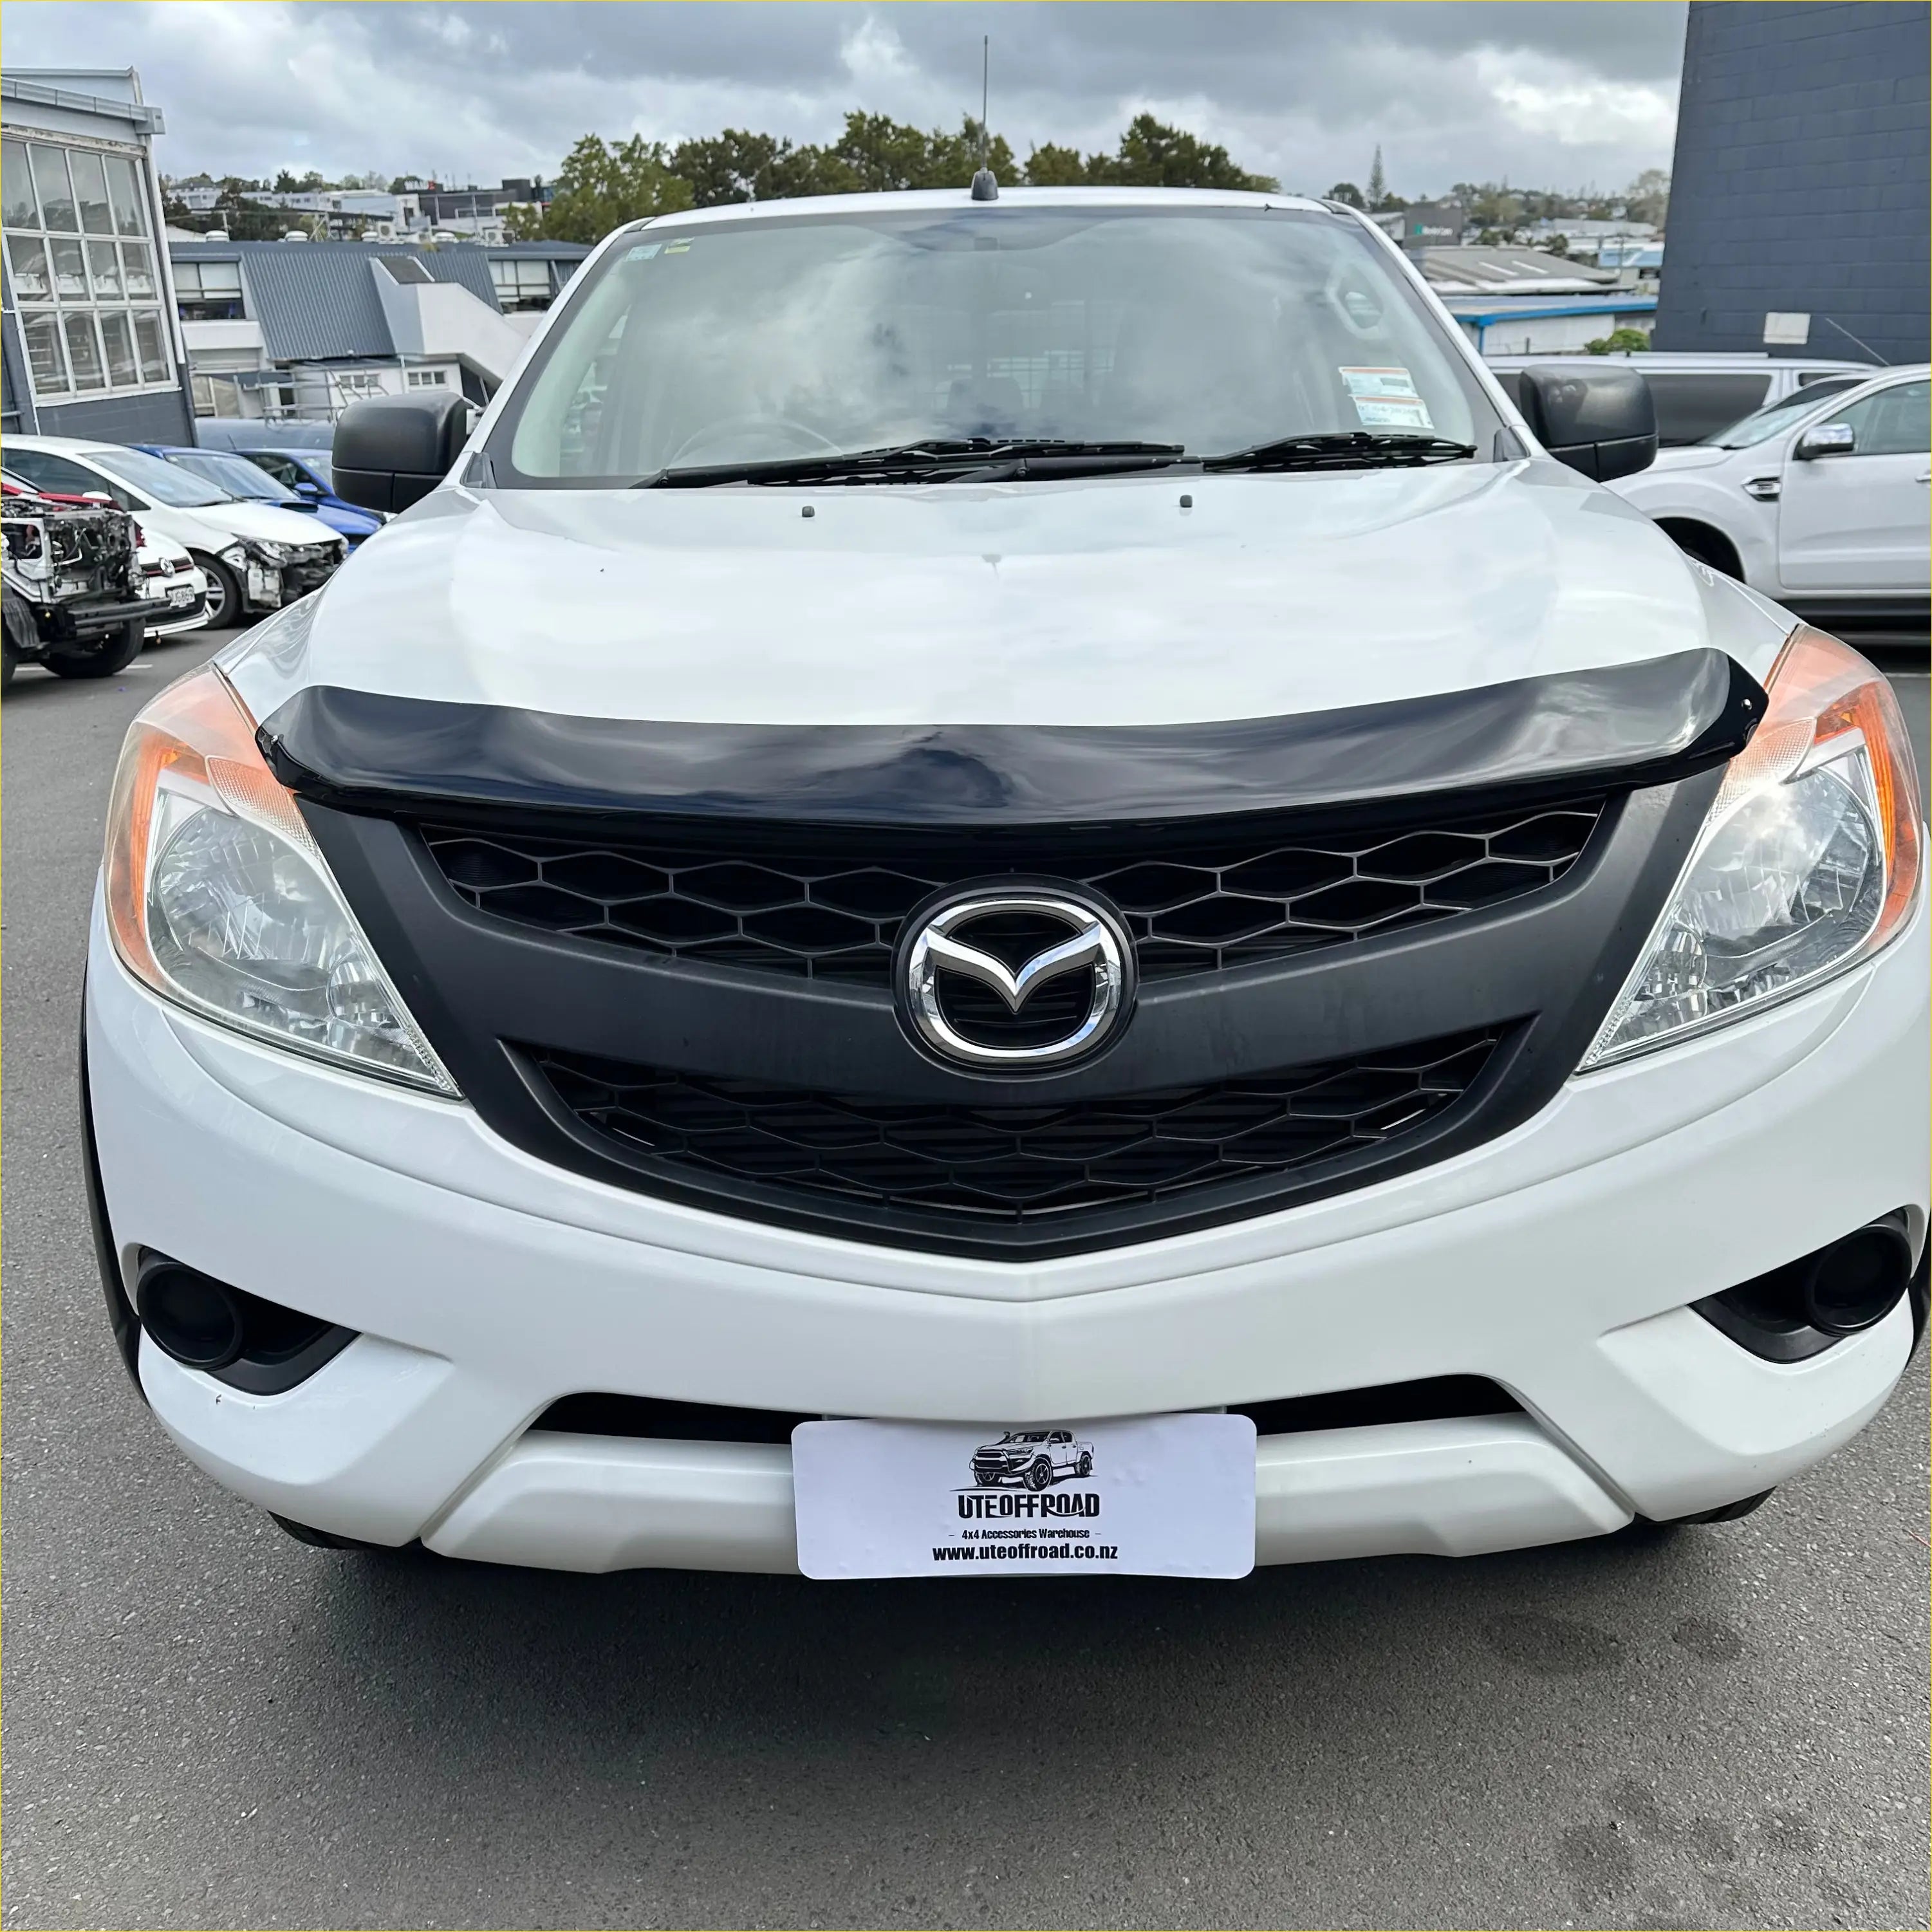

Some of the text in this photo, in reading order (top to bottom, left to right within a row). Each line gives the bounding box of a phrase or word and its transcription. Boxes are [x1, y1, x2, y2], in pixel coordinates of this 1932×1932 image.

[958, 1493, 1100, 1519] UTEOFFROAD
[961, 1528, 1090, 1540] 4x4 Accessories Warehouse
[932, 1543, 1118, 1561] www.uteoffroad.co.nz
